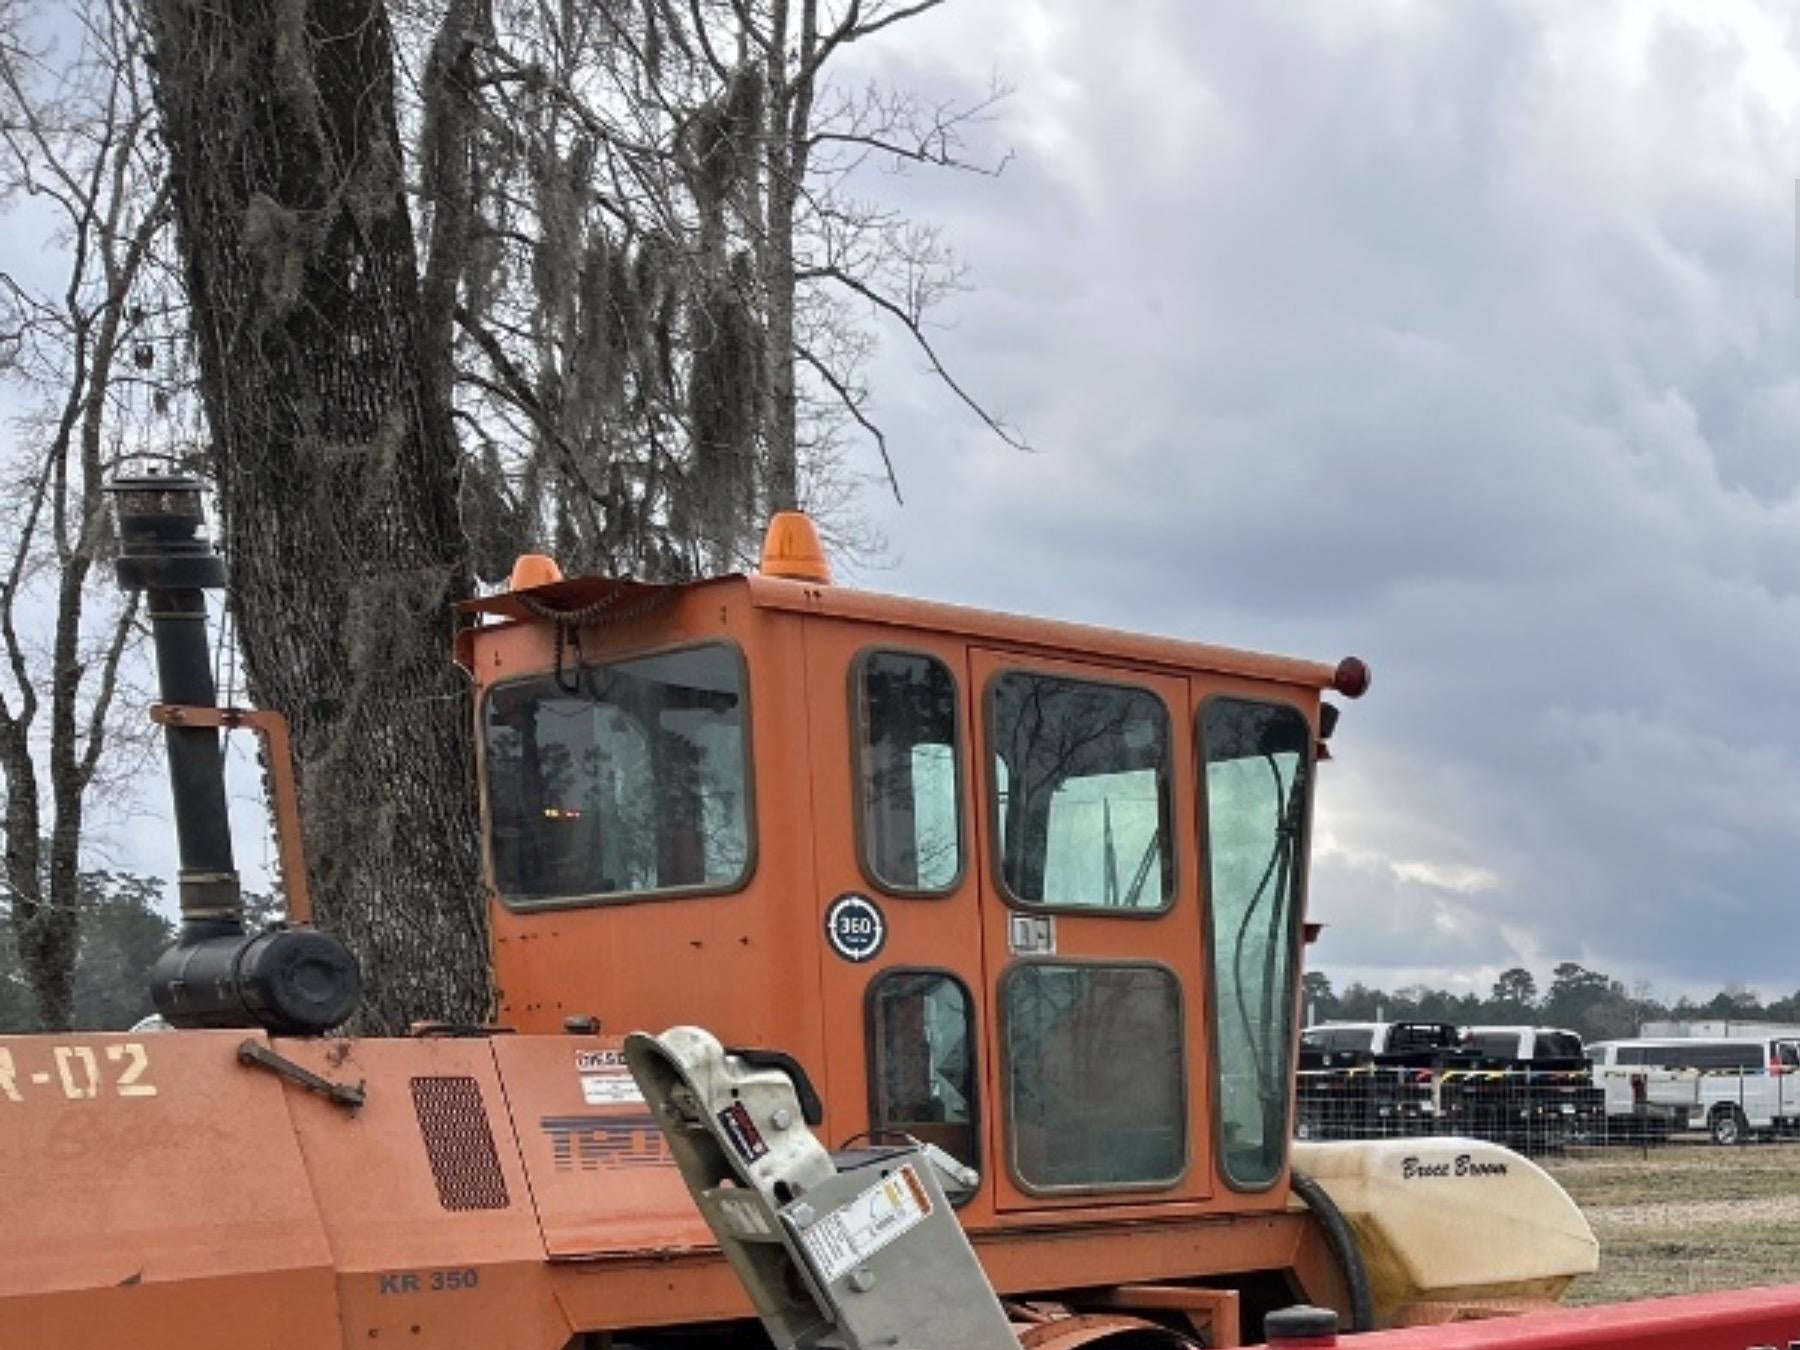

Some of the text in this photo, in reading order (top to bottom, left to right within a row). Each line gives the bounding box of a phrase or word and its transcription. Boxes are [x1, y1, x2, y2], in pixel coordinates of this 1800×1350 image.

[839, 917, 871, 934] 360
[1402, 1154, 1508, 1180] Broce Broom
[379, 1268, 480, 1296] KR 350
